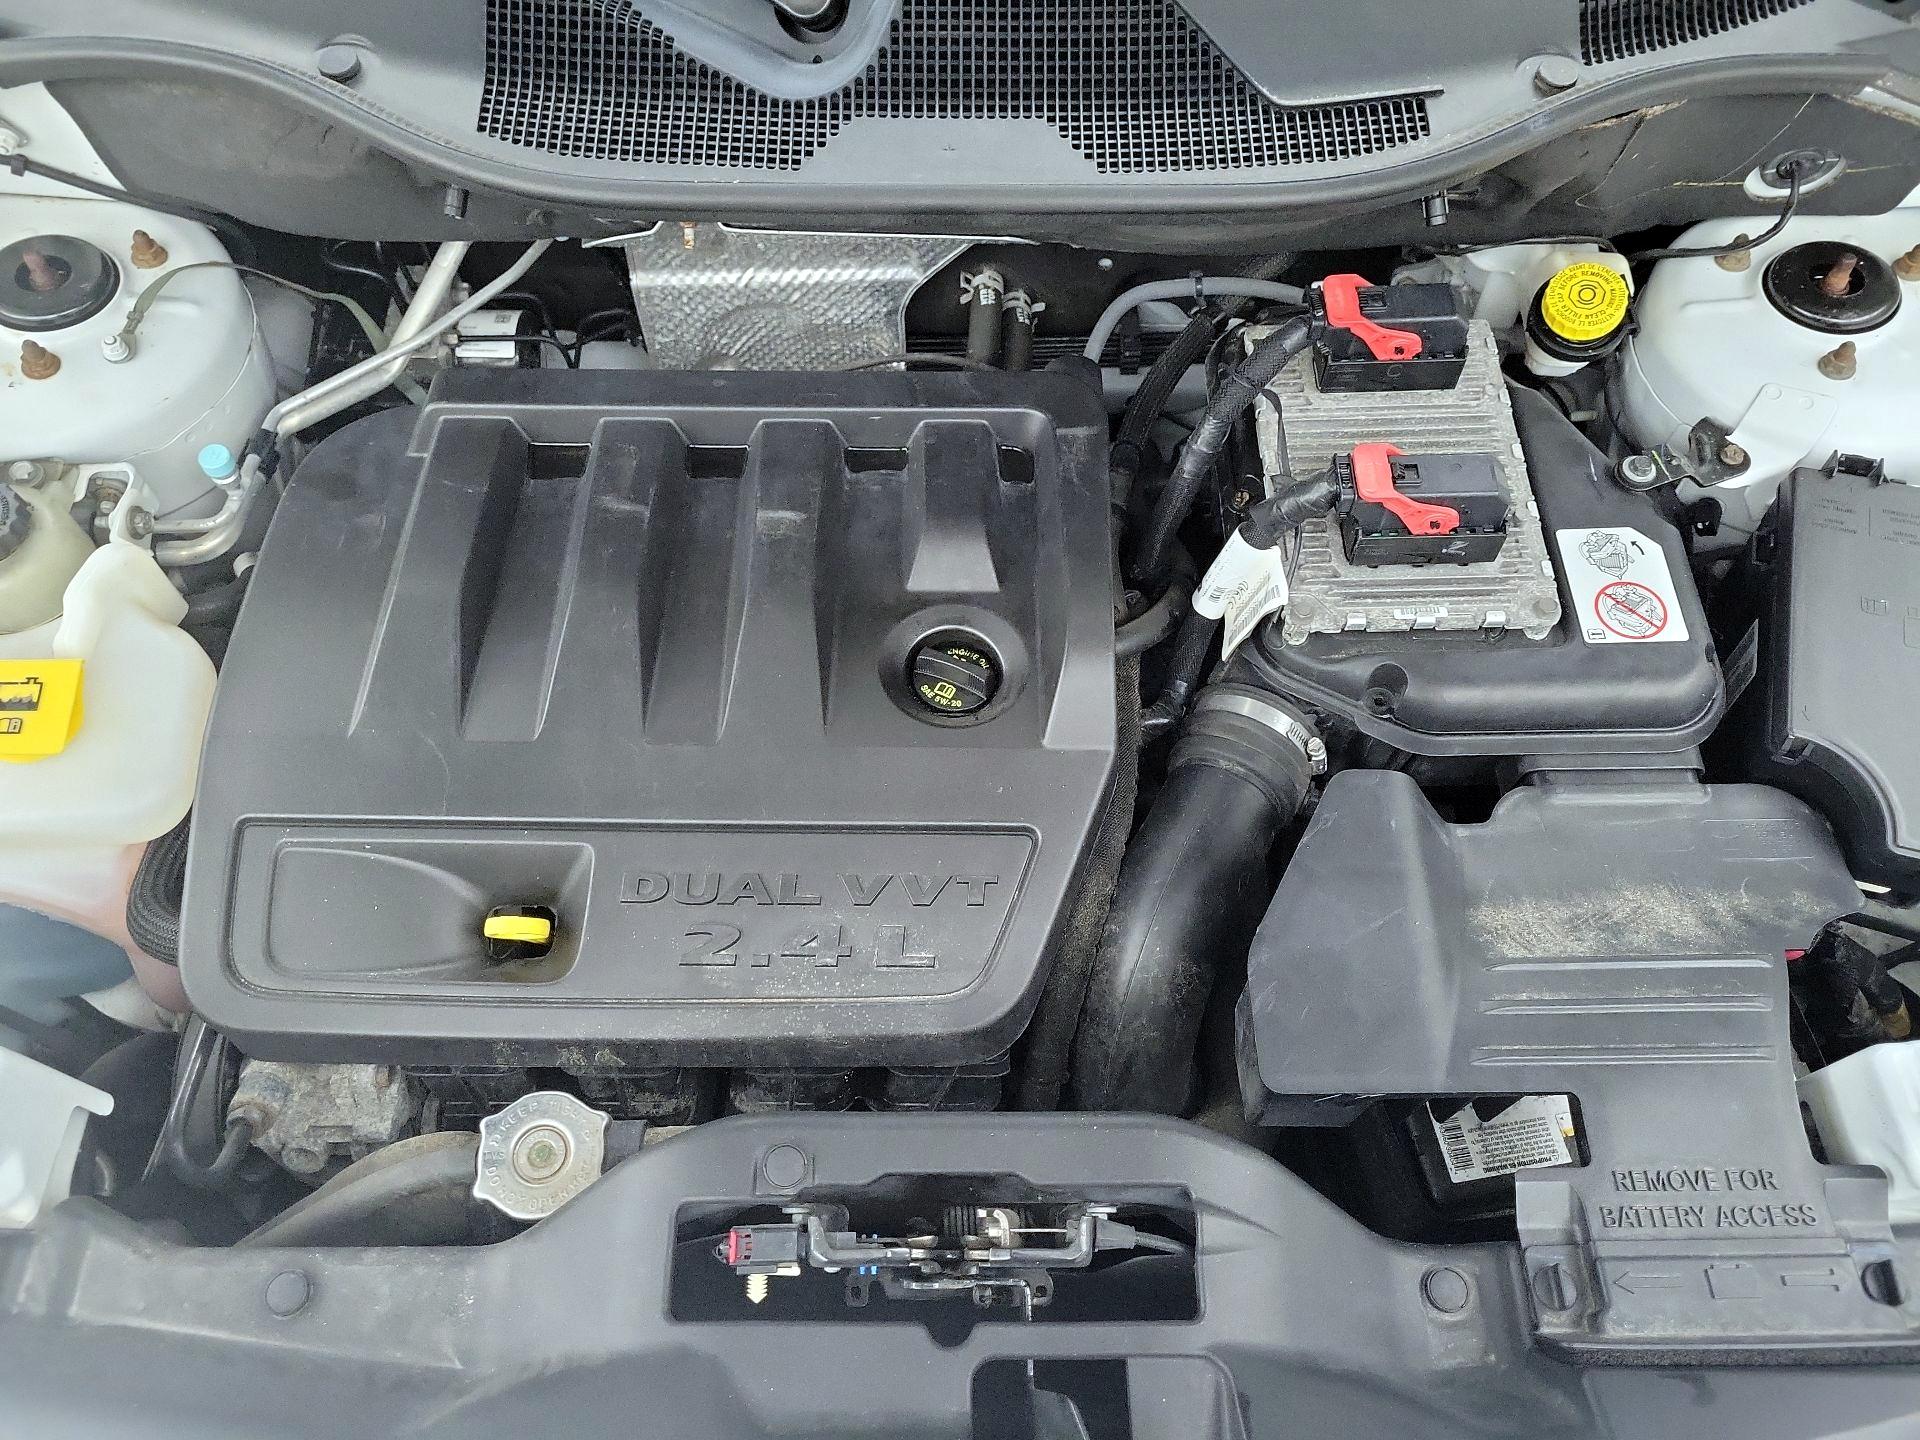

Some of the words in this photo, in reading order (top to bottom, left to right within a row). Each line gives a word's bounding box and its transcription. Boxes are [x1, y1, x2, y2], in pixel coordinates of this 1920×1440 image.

[920, 684, 936, 698] SAE
[934, 696, 962, 707] 5W-20
[619, 871, 822, 905] DUAL
[837, 873, 999, 907] VVT
[1612, 1168, 1721, 1192] REMOVE
[1724, 1168, 1781, 1192] FOR
[1600, 1204, 1704, 1228] BATTERY
[1717, 1203, 1818, 1228] ACCESS
